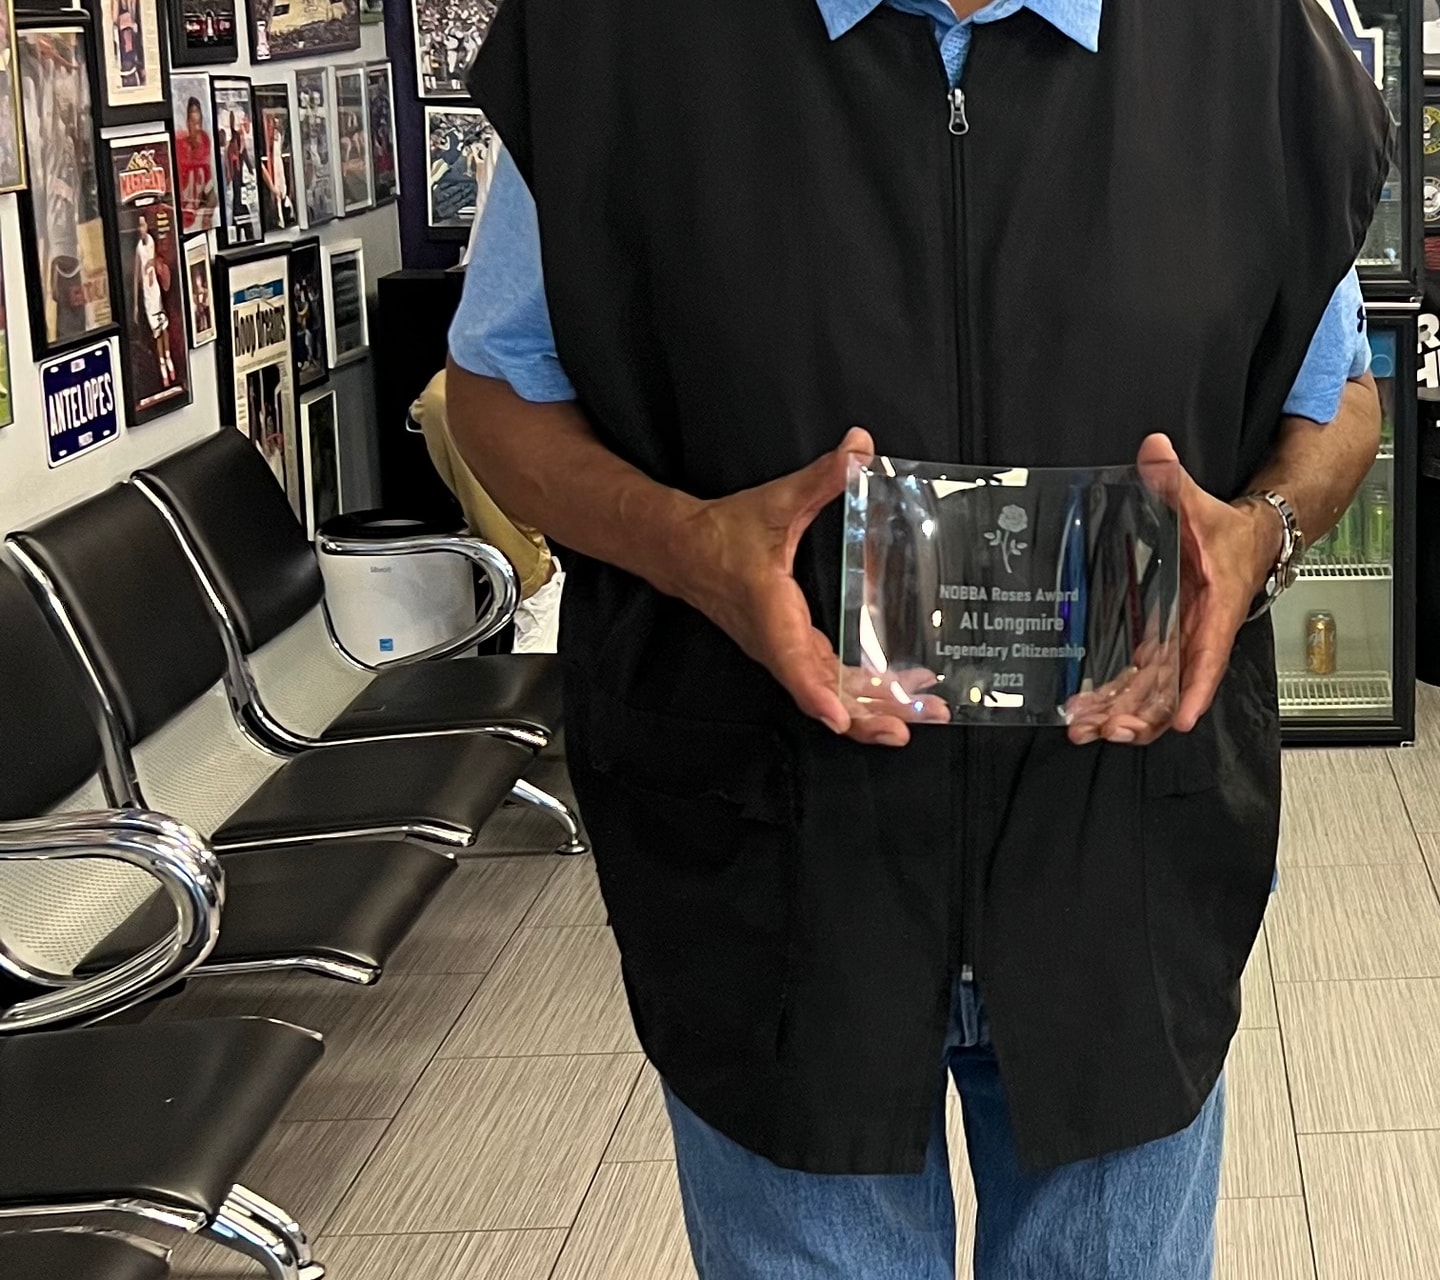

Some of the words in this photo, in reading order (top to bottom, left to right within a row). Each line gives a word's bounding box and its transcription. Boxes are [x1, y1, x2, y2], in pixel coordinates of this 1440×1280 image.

[48, 372, 114, 437] ANTELOPES
[939, 585, 987, 602] NOBBA
[990, 586, 1032, 603] Roses
[1035, 586, 1079, 603] Award
[960, 612, 979, 630] Al
[984, 612, 1064, 635] Longmire
[936, 641, 1009, 661] Legendary
[1011, 643, 1086, 662] Citizenship
[993, 673, 1024, 687] 2023
